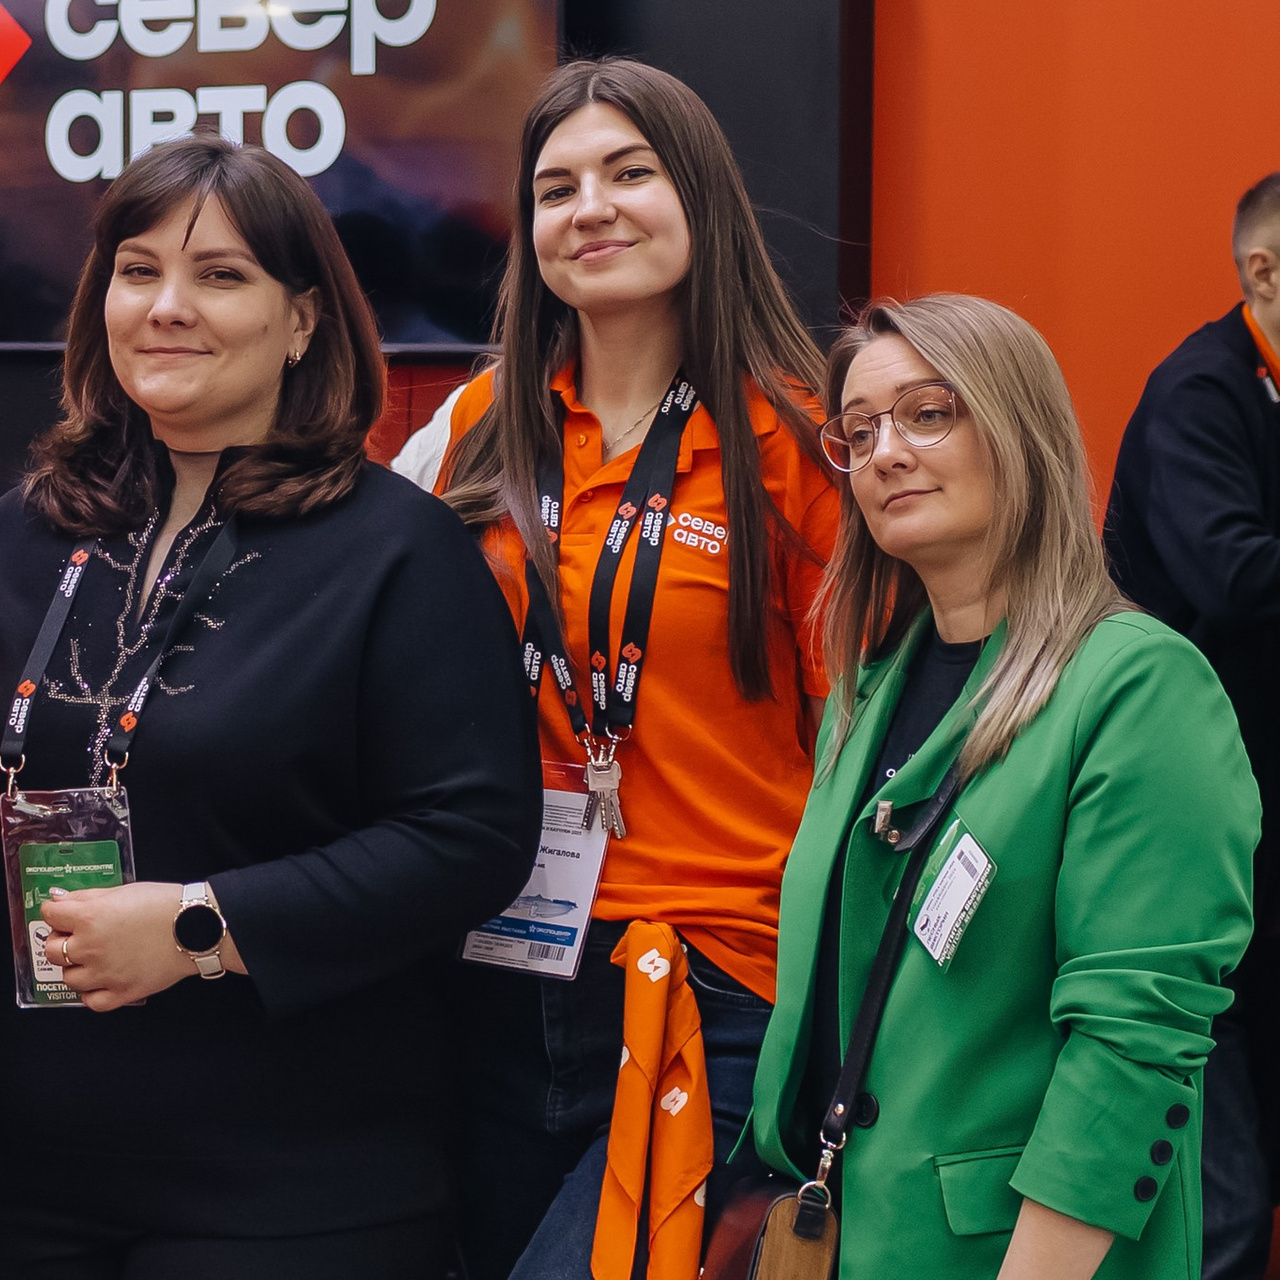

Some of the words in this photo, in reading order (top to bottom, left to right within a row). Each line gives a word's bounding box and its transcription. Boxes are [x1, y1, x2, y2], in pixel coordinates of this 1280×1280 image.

[550, 501, 559, 527] авто
[642, 512, 654, 538] авто
[606, 519, 621, 546] авто
[612, 520, 629, 554] север
[650, 512, 663, 546] север
[673, 528, 720, 554] авто
[60, 566, 74, 591] авто
[65, 566, 82, 598] север
[530, 651, 541, 680] авто
[551, 654, 567, 690] север
[616, 663, 627, 692] авто
[622, 664, 637, 702] север
[9, 698, 22, 726] авто
[15, 698, 30, 733] север
[539, 845, 580, 859] Жигалова
[36, 983, 71, 992] ПОСЕТИ
[47, 991, 77, 1000] VISITOR
